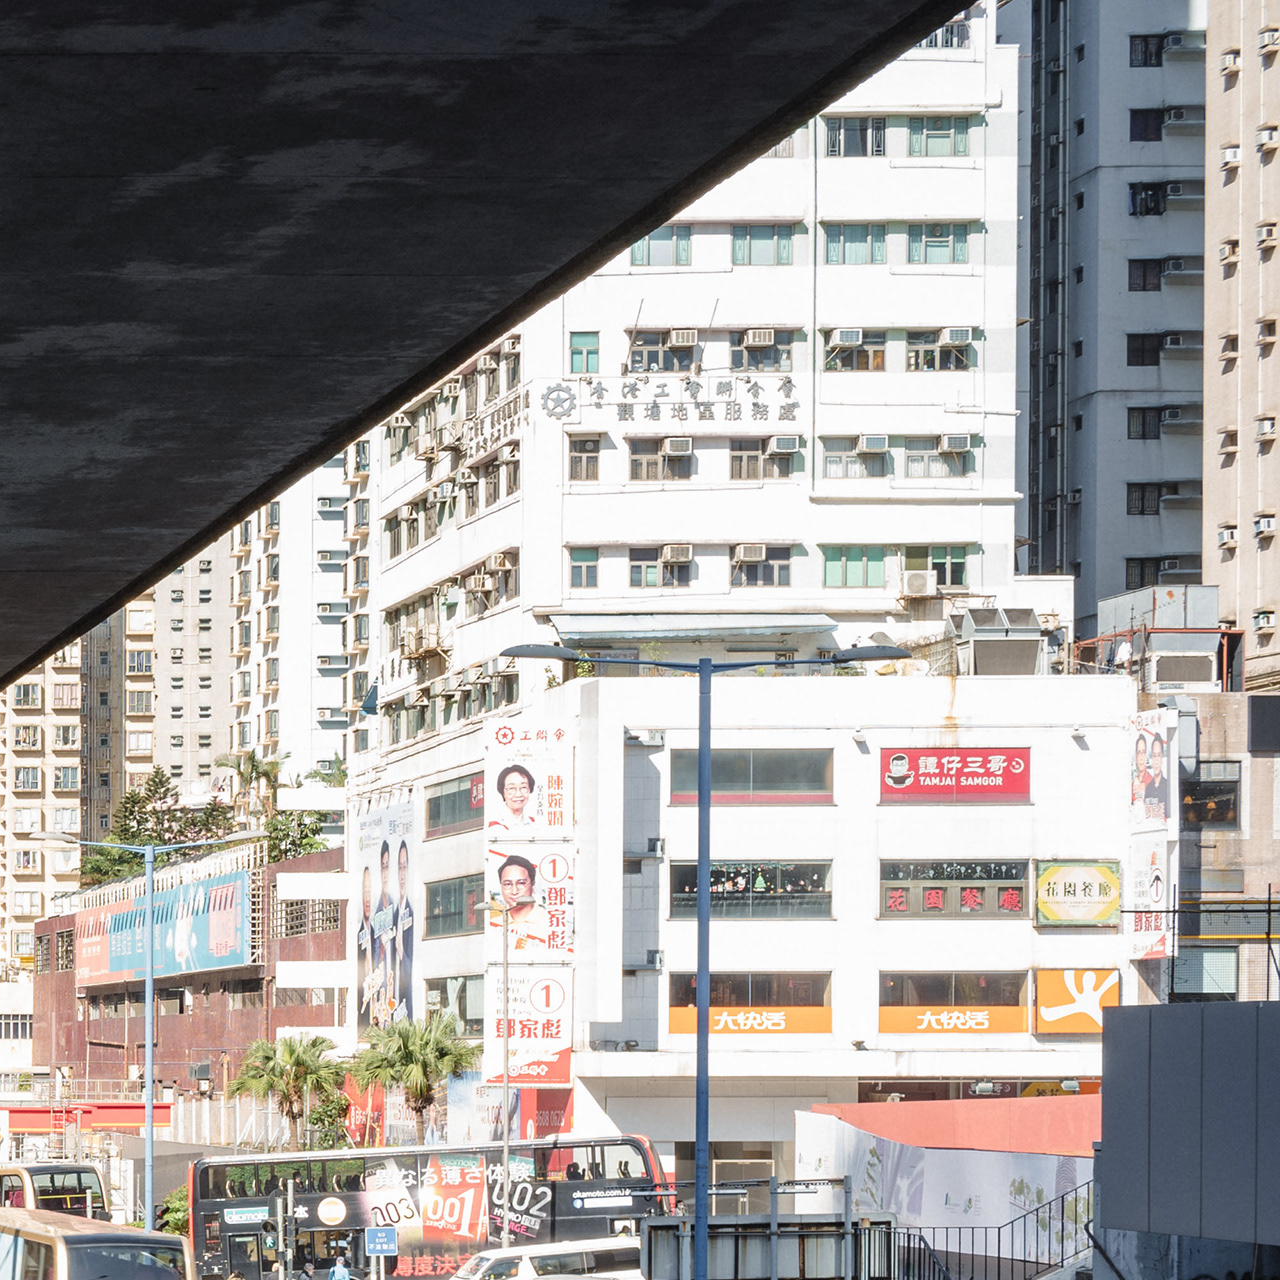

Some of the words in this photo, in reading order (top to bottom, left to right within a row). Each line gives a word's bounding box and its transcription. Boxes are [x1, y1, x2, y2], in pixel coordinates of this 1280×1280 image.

[616, 402, 797, 422] 觀塘地區服務處
[520, 728, 565, 743] 工聯會
[919, 777, 955, 786] TAMJAI
[960, 777, 1003, 786] SAMGOR
[887, 888, 1022, 912] 花園餐廳
[547, 887, 566, 949] 鄧家彪
[713, 1011, 786, 1030] 大快活
[916, 1010, 990, 1030] 大快活
